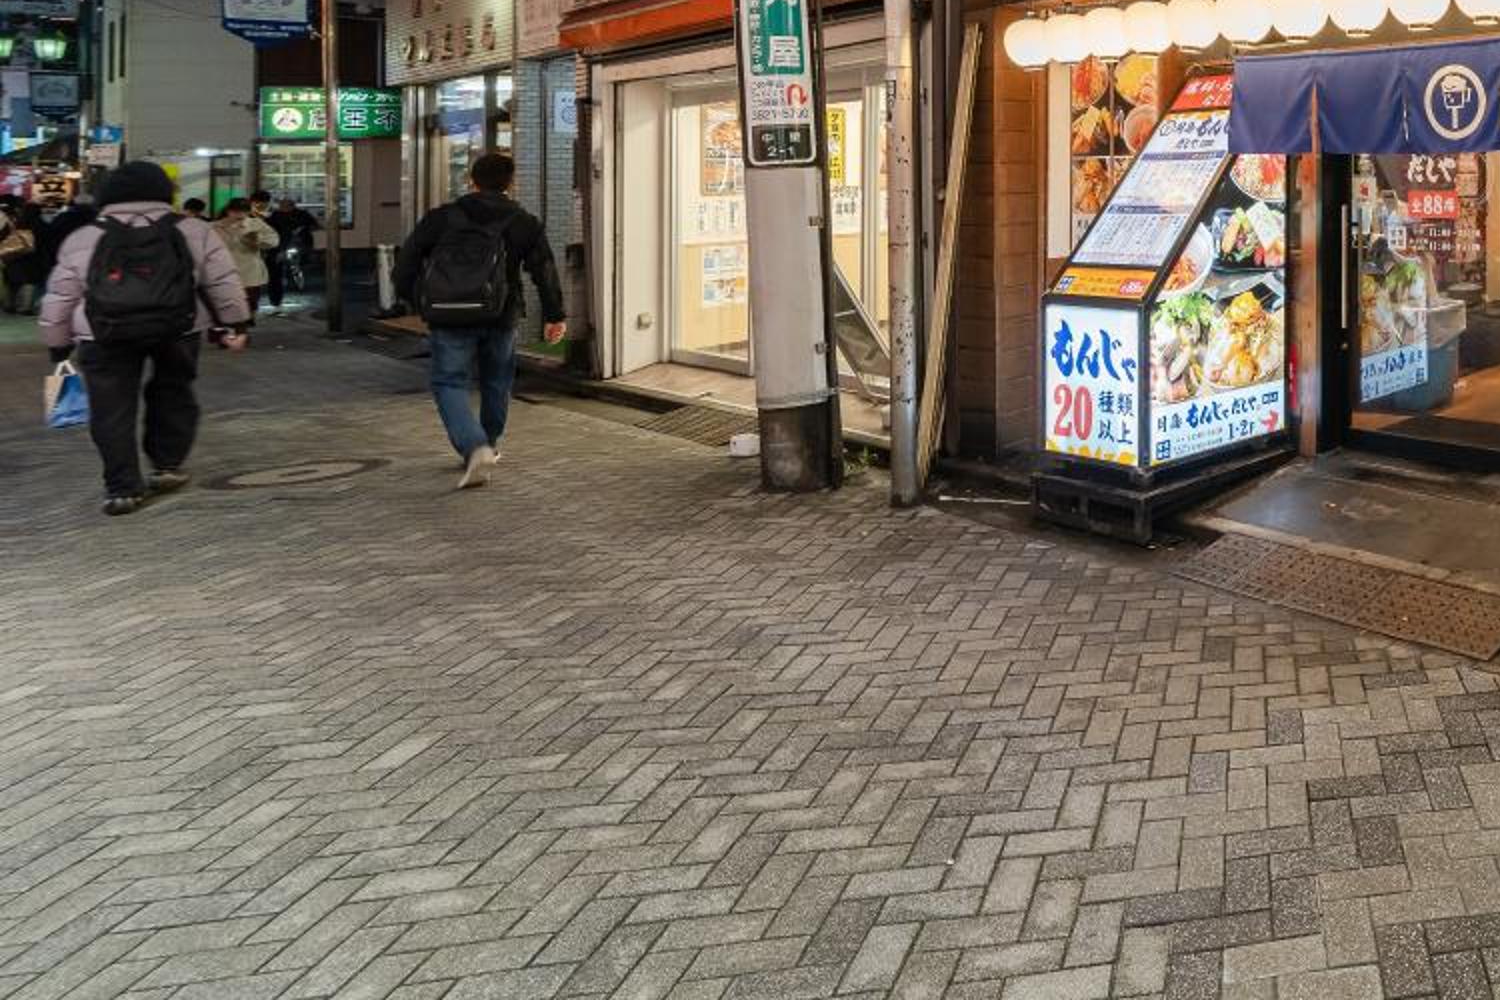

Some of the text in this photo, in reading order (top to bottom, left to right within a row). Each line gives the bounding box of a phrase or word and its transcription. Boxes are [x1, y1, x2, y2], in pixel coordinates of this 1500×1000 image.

[1051, 319, 1136, 383] もんじゃ
[1054, 384, 1093, 441] 20
[1098, 391, 1134, 417] 種類
[1098, 419, 1133, 445] 以上
